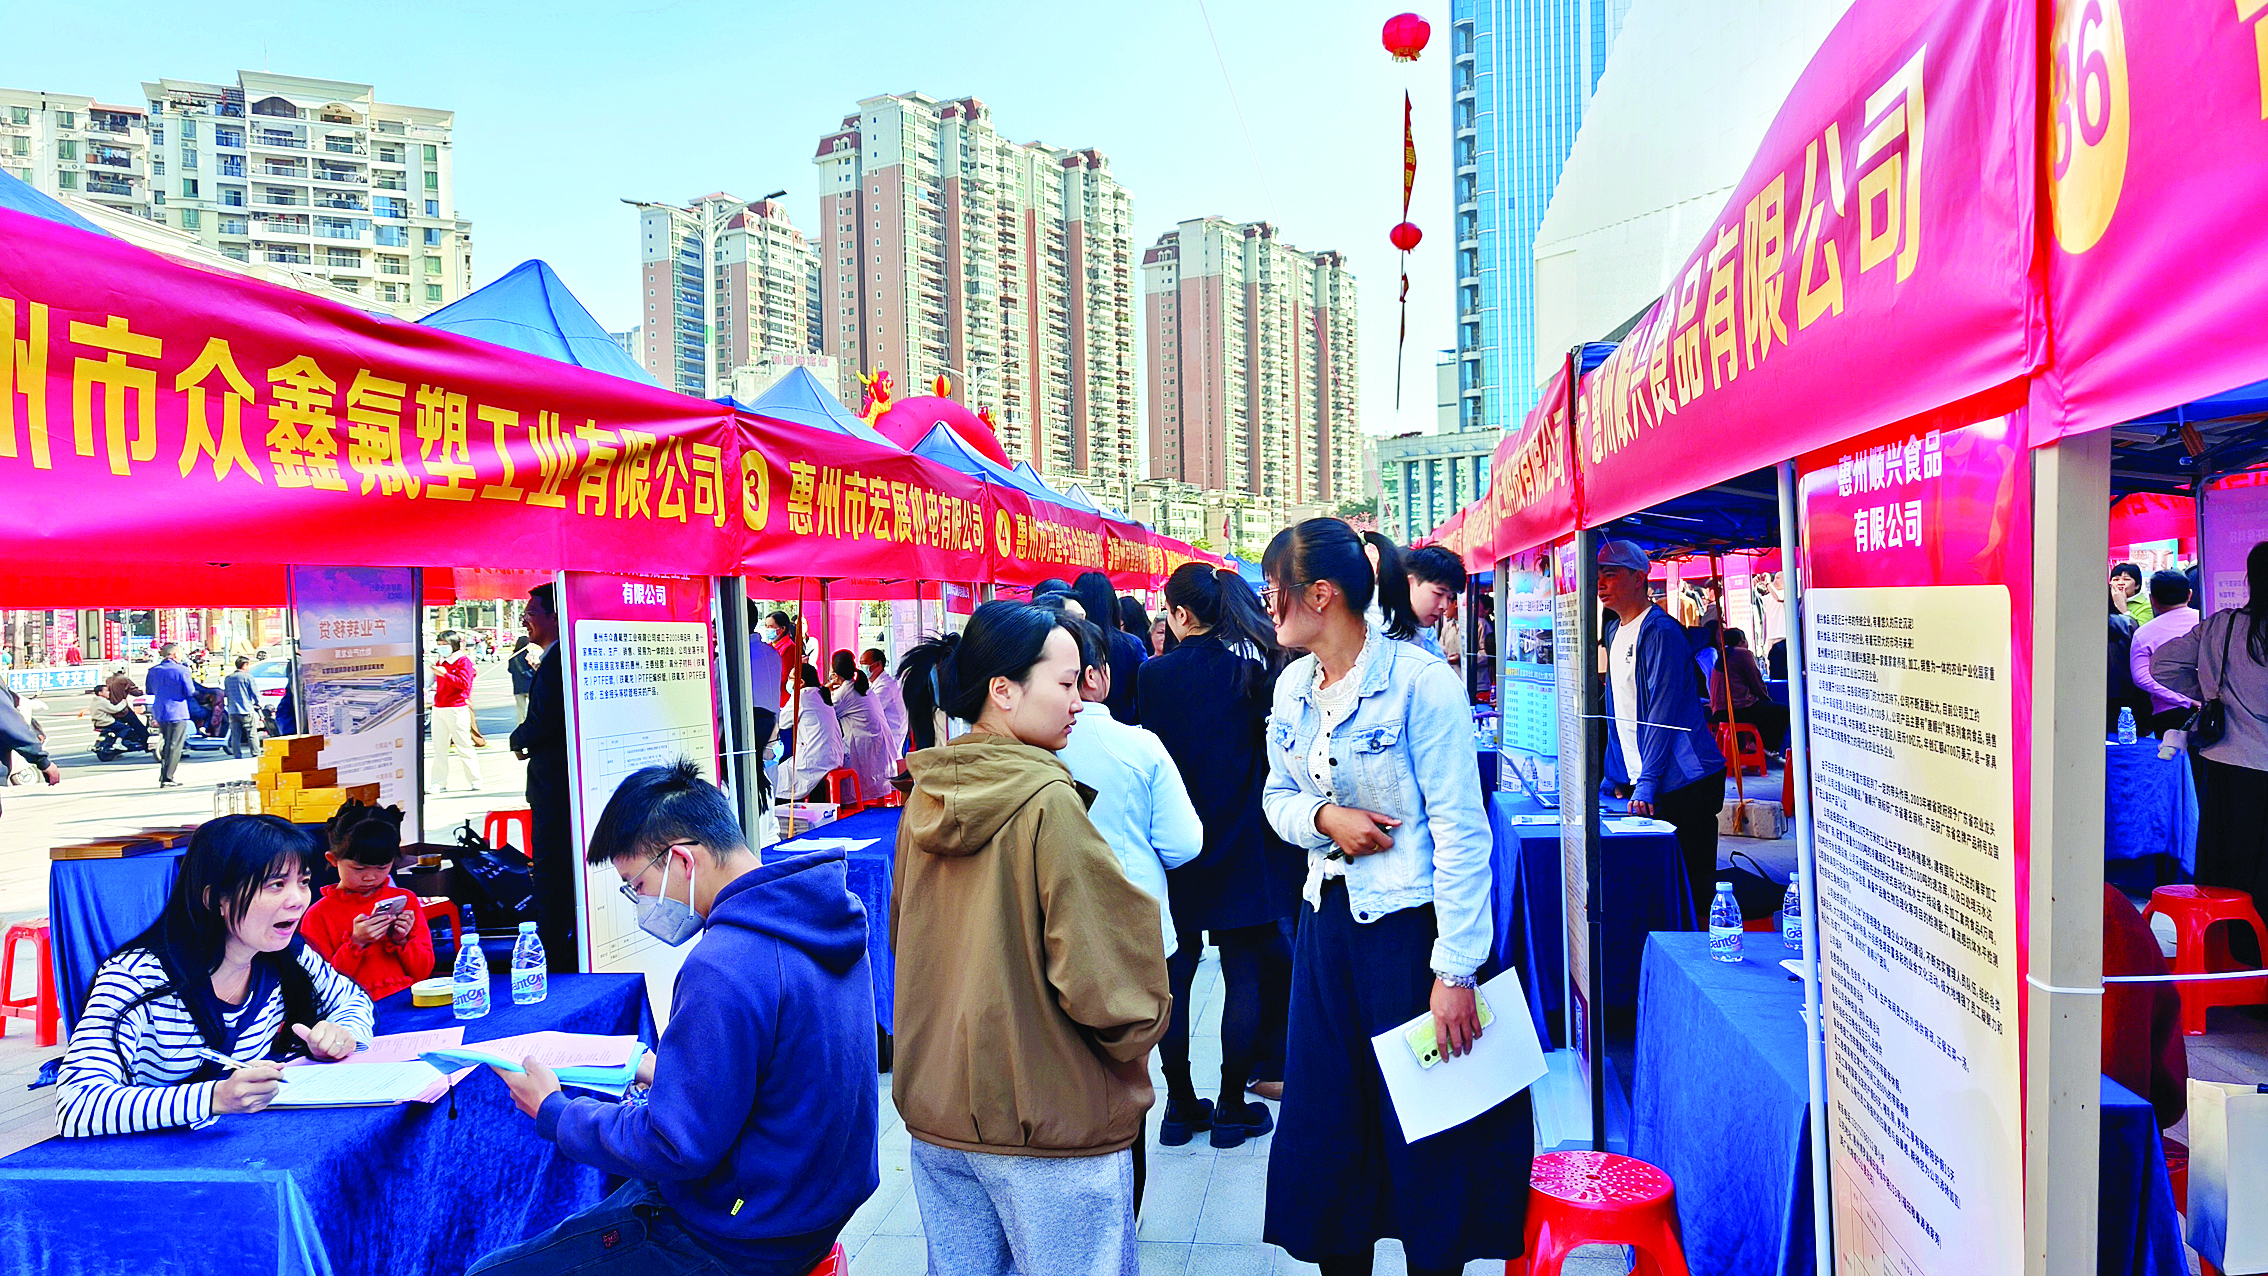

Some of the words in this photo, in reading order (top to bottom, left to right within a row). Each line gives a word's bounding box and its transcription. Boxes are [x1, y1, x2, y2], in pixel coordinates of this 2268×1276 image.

[1590, 44, 1928, 466] 惠州顺兴食品有限公司
[1837, 428, 1943, 498] 惠州顺兴食品
[787, 460, 985, 556] 惠州市宏展机电有限公司
[1853, 503, 1924, 551] 有限公司
[622, 582, 667, 606] 有限公司
